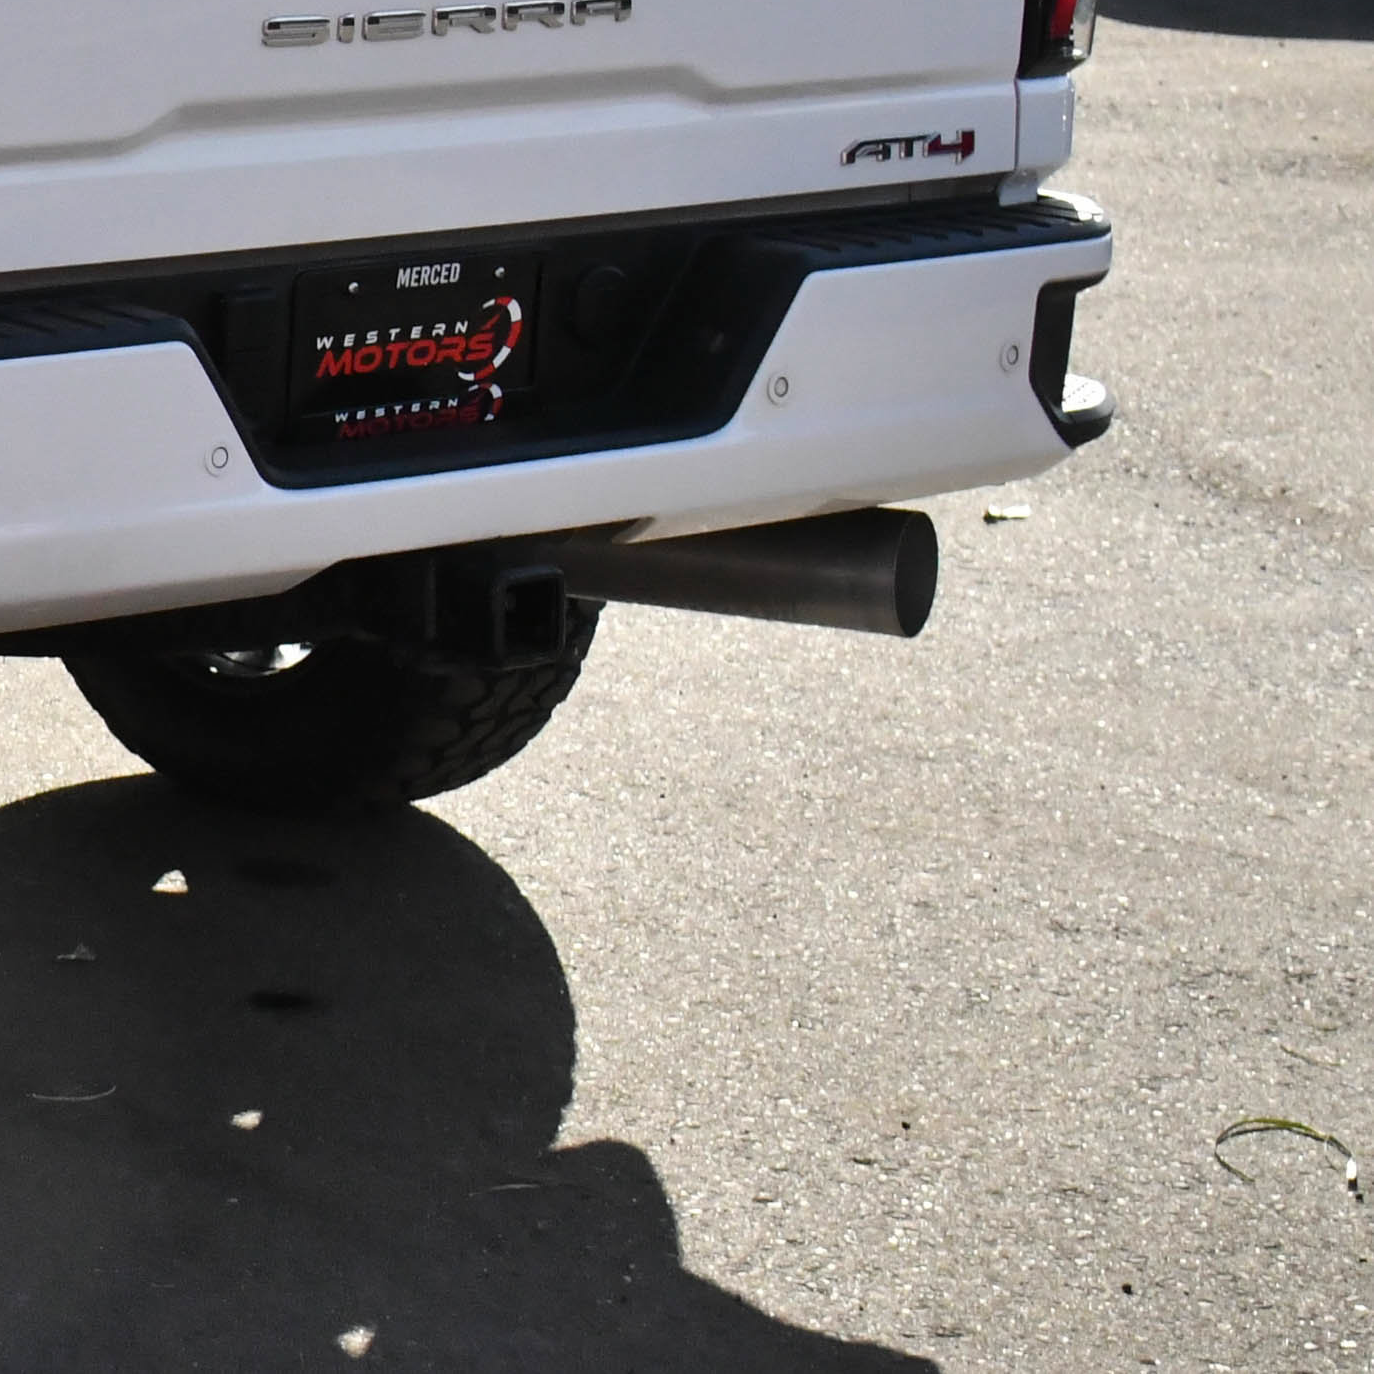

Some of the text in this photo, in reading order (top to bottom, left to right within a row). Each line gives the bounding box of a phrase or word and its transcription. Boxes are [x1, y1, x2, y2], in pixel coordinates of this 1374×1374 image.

[840, 129, 975, 166] AT4
[396, 263, 460, 289] MERCED
[316, 321, 468, 350] WESTERN
[316, 332, 495, 379] MOTORS
[335, 398, 458, 422] WESTERN
